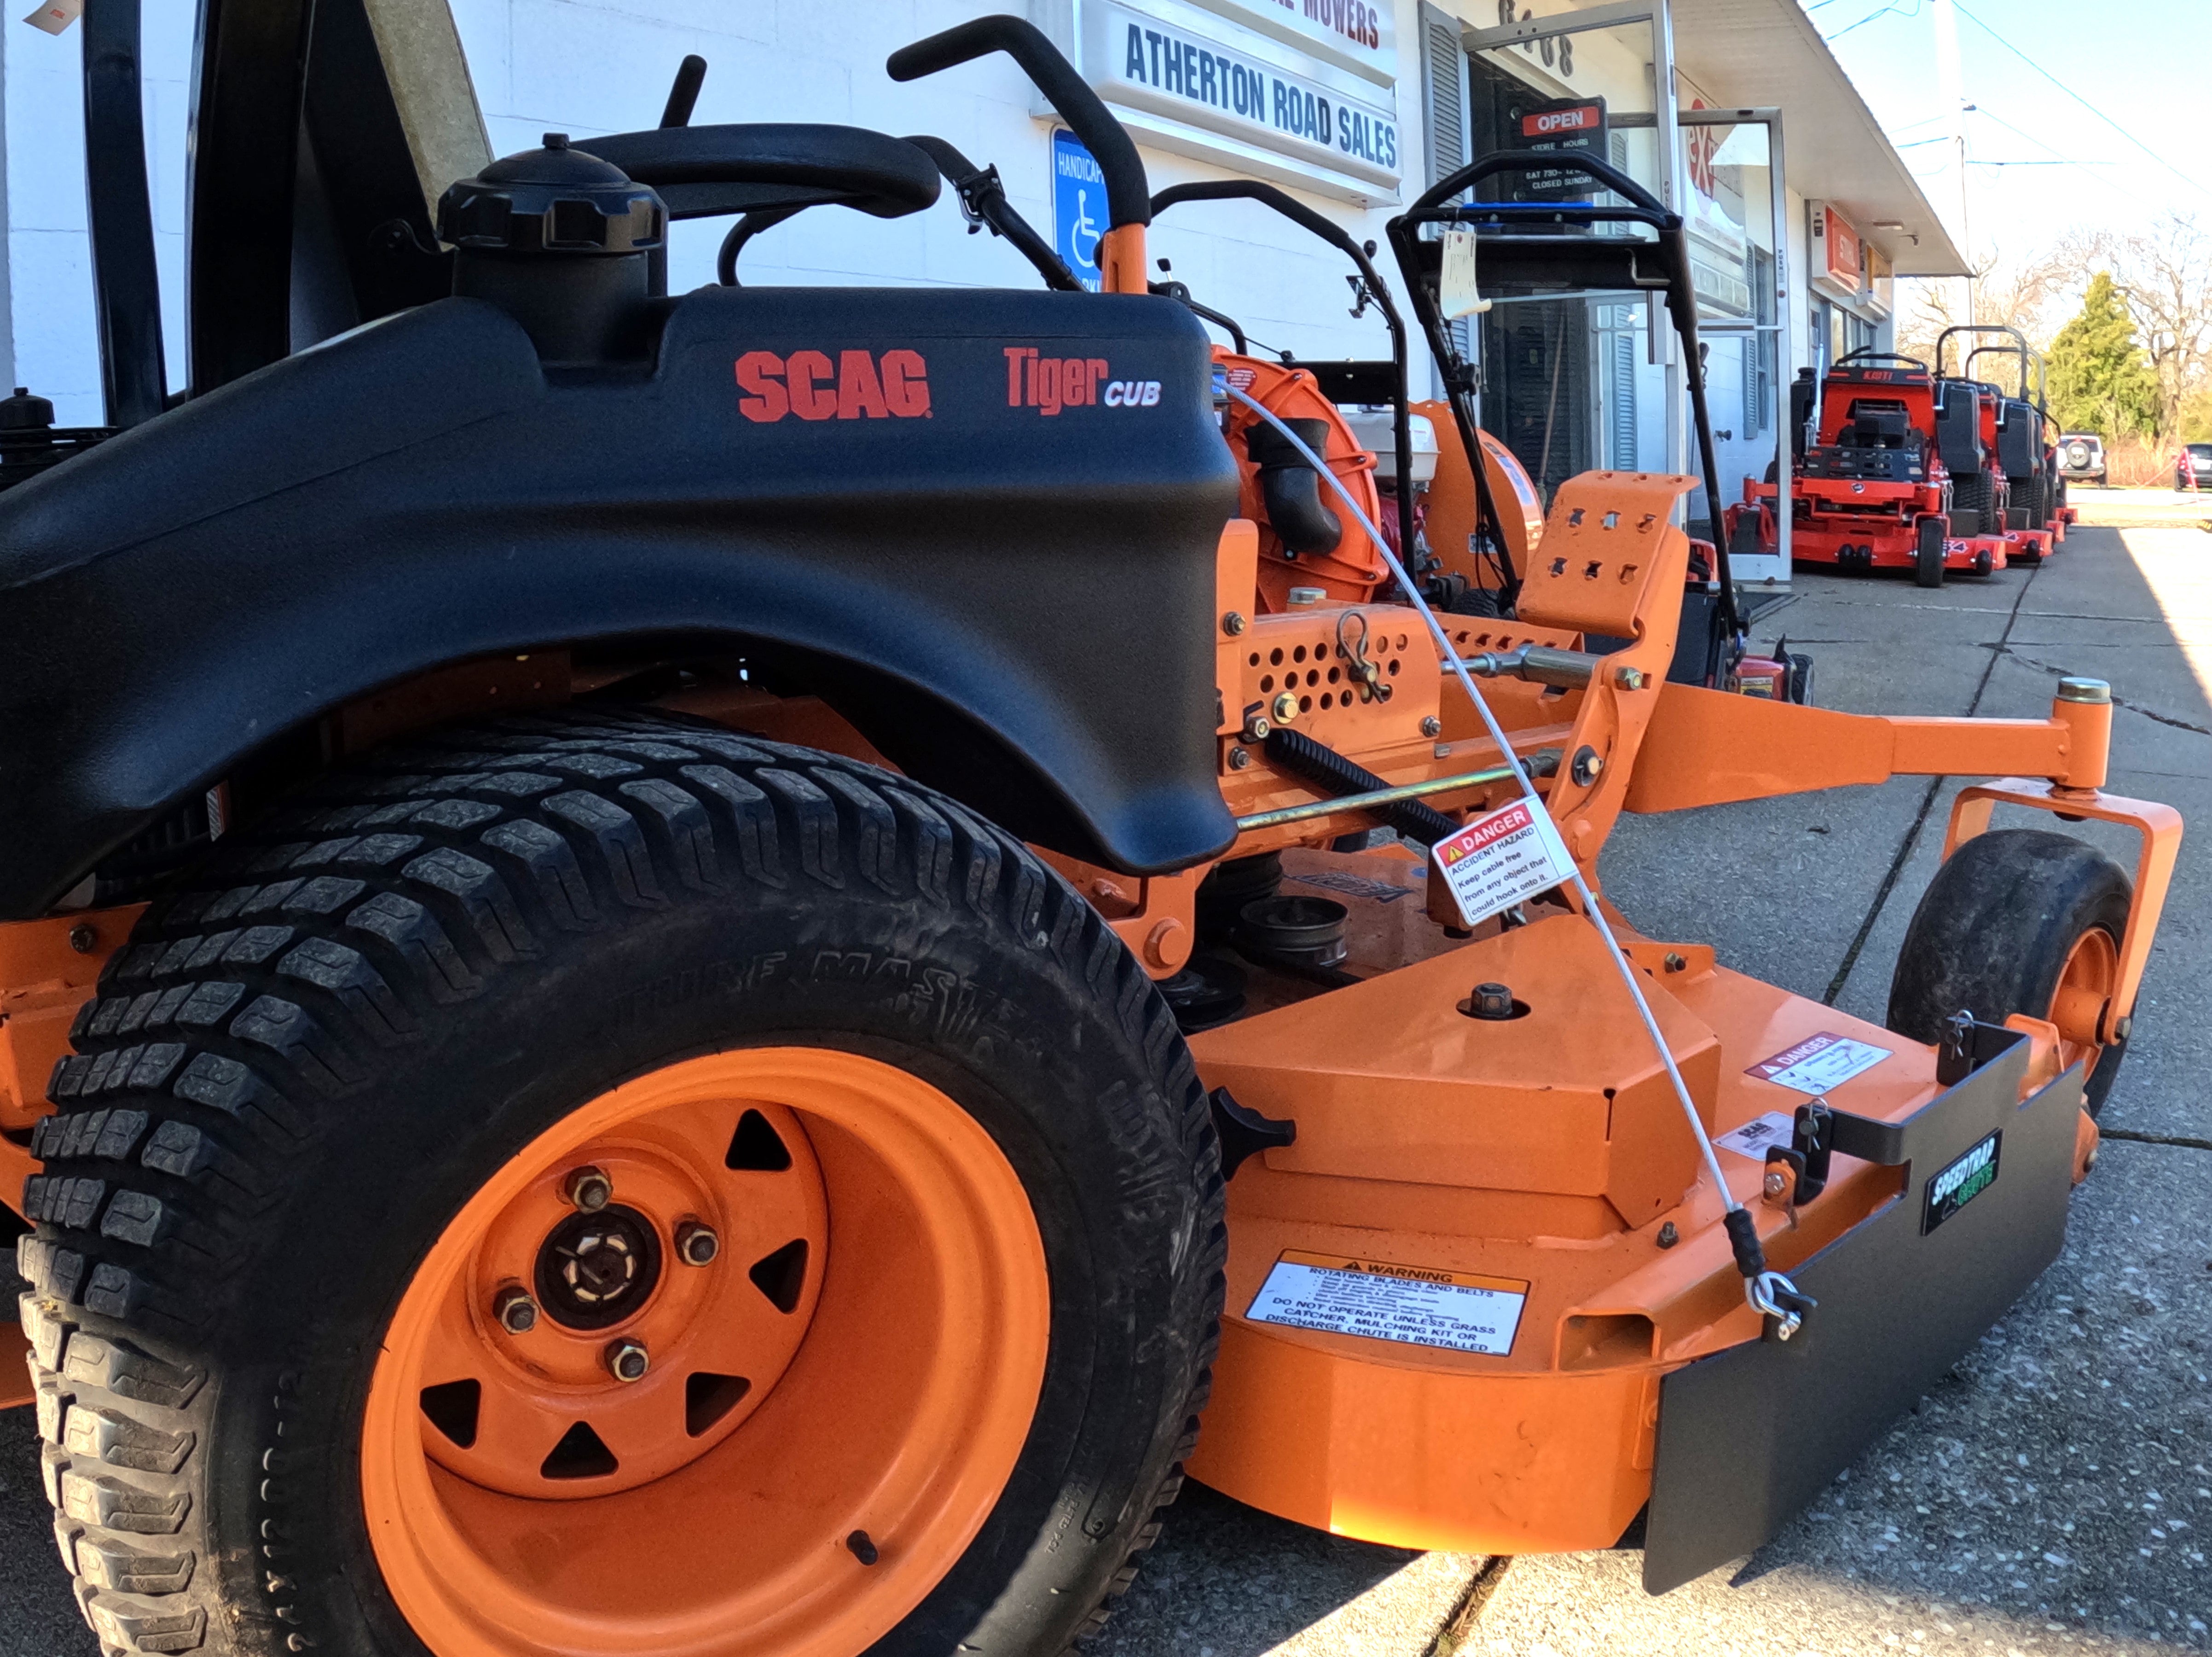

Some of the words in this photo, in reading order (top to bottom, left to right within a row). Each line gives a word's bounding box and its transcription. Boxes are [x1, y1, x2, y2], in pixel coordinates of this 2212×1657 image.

[1303, 0, 1379, 50] MOWERS
[1126, 23, 1265, 123] ATHERTON
[1274, 79, 1332, 145] ROAD
[1338, 106, 1396, 169] SALES
[1537, 110, 1583, 131] OPEN
[1563, 139, 1589, 148] HOURS
[1526, 171, 1541, 180] SAT
[1532, 179, 1562, 190] CLOSED
[1564, 176, 1592, 186] SUNDAY
[735, 349, 931, 423] SCAG
[1003, 347, 1108, 416] Tiger
[1105, 382, 1161, 407] CUB
[1461, 810, 1527, 851] DANGER
[1451, 846, 1496, 875] ACCIDENT
[1497, 827, 1535, 851] HAZARD
[1457, 873, 1480, 889] Keep
[1482, 861, 1505, 876] cable
[1505, 852, 1522, 863] free
[1465, 890, 1485, 902] from
[1486, 880, 1501, 892] any
[1503, 865, 1529, 882] object
[1529, 856, 1547, 869] that
[1471, 899, 1495, 916] could
[1495, 887, 1518, 902] hook
[1520, 879, 1538, 891] onto
[1539, 874, 1548, 884] it.
[1776, 1037, 1835, 1066] DANGER
[1309, 1268, 1370, 1281] ROTATING
[1373, 1276, 1422, 1288] BLADES
[1425, 1284, 1453, 1292] AND
[1456, 1287, 1494, 1298] BELTS
[1367, 1264, 1453, 1283] WARNING
[1266, 1313, 1343, 1332] DISCHARGE
[1347, 1326, 1393, 1338] CHUTE
[1413, 1336, 1488, 1351] INSTALLED
[1272, 1297, 1292, 1305] DO
[1296, 1300, 1327, 1311] NOT
[1328, 1305, 1389, 1320] OPERATE
[1393, 1314, 1446, 1327] UNLESS
[1450, 1322, 1496, 1334] GRASS
[1354, 1318, 1427, 1334] MULCHING
[1431, 1328, 1453, 1338] KIT
[1457, 1333, 1477, 1341] OR
